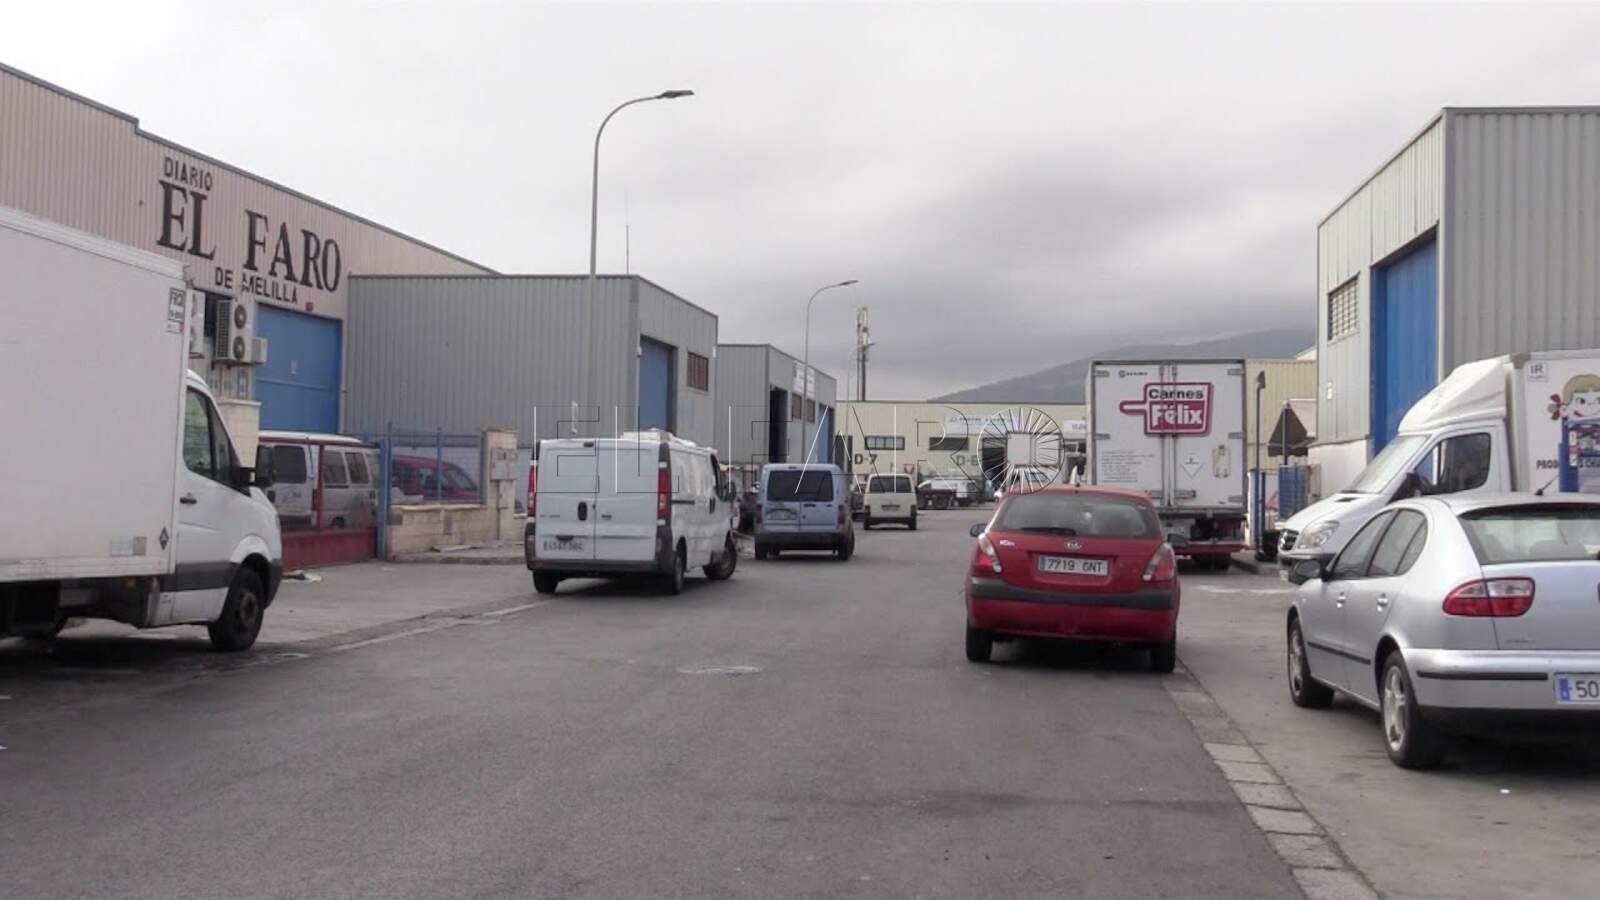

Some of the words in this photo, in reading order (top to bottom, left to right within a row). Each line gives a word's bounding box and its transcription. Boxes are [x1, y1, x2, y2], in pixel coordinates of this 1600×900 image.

[164, 157, 213, 191] DIARIO
[157, 180, 217, 261] EL
[244, 209, 342, 293] FARO
[215, 267, 233, 289] DE
[241, 273, 298, 304] MELILLA
[1149, 388, 1204, 400] Carnes
[1151, 404, 1202, 428] Félix
[1047, 558, 1075, 571] 7719
[1082, 562, 1104, 573] GNT
